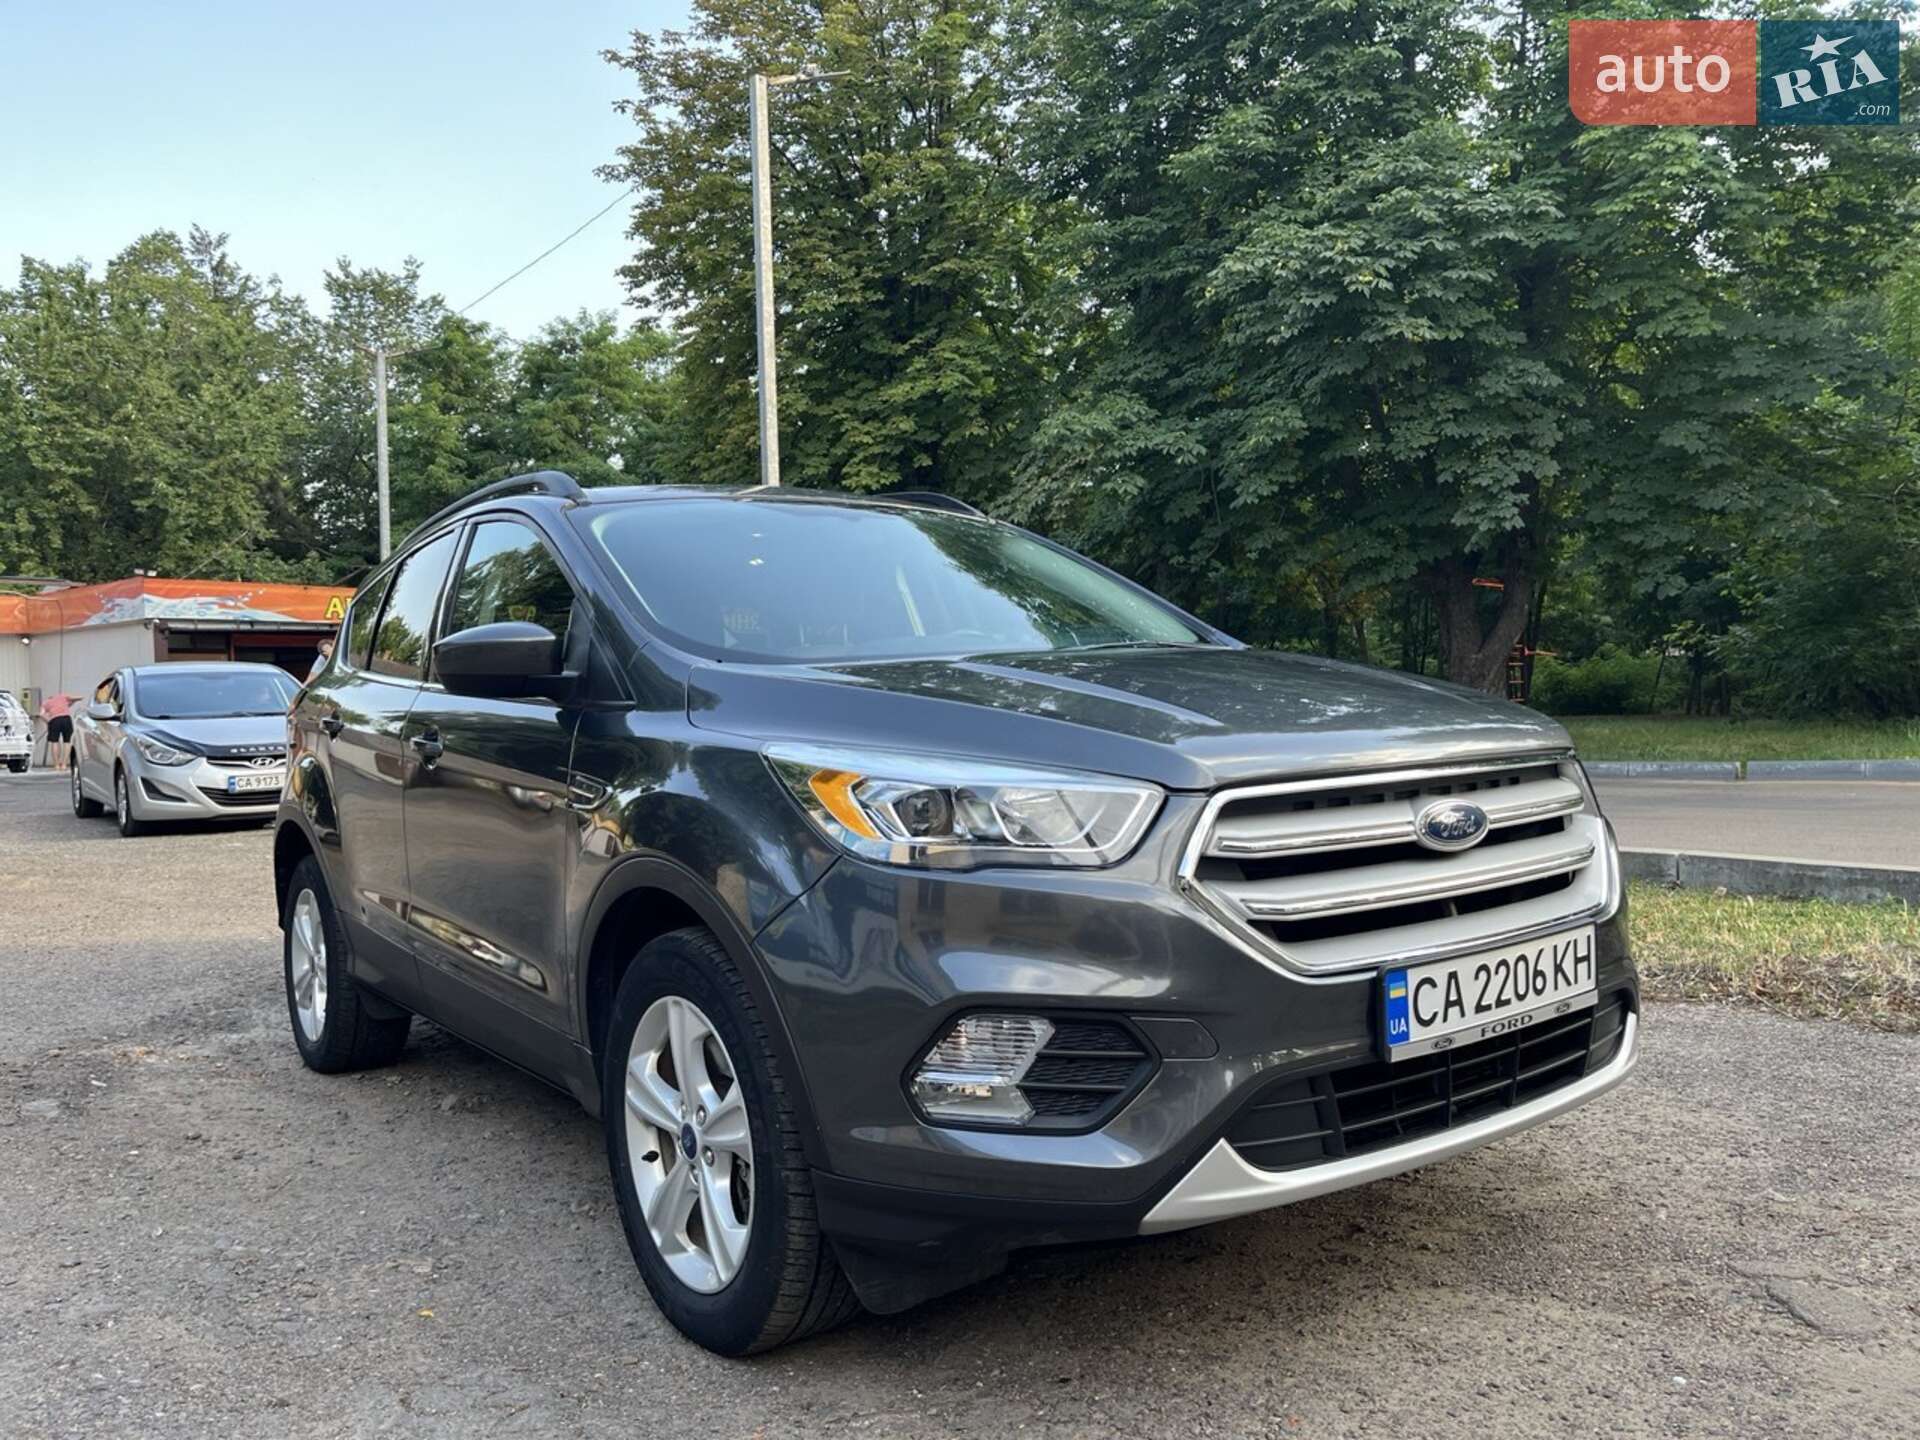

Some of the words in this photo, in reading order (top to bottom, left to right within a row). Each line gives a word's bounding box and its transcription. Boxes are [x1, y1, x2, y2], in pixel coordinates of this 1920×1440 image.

[237, 778, 252, 788] CA
[1412, 970, 1466, 1028] CA
[1474, 947, 1547, 1014] 2206
[1553, 934, 1592, 991] KH
[1390, 1016, 1408, 1035] UA
[1480, 1014, 1534, 1038] FORD
